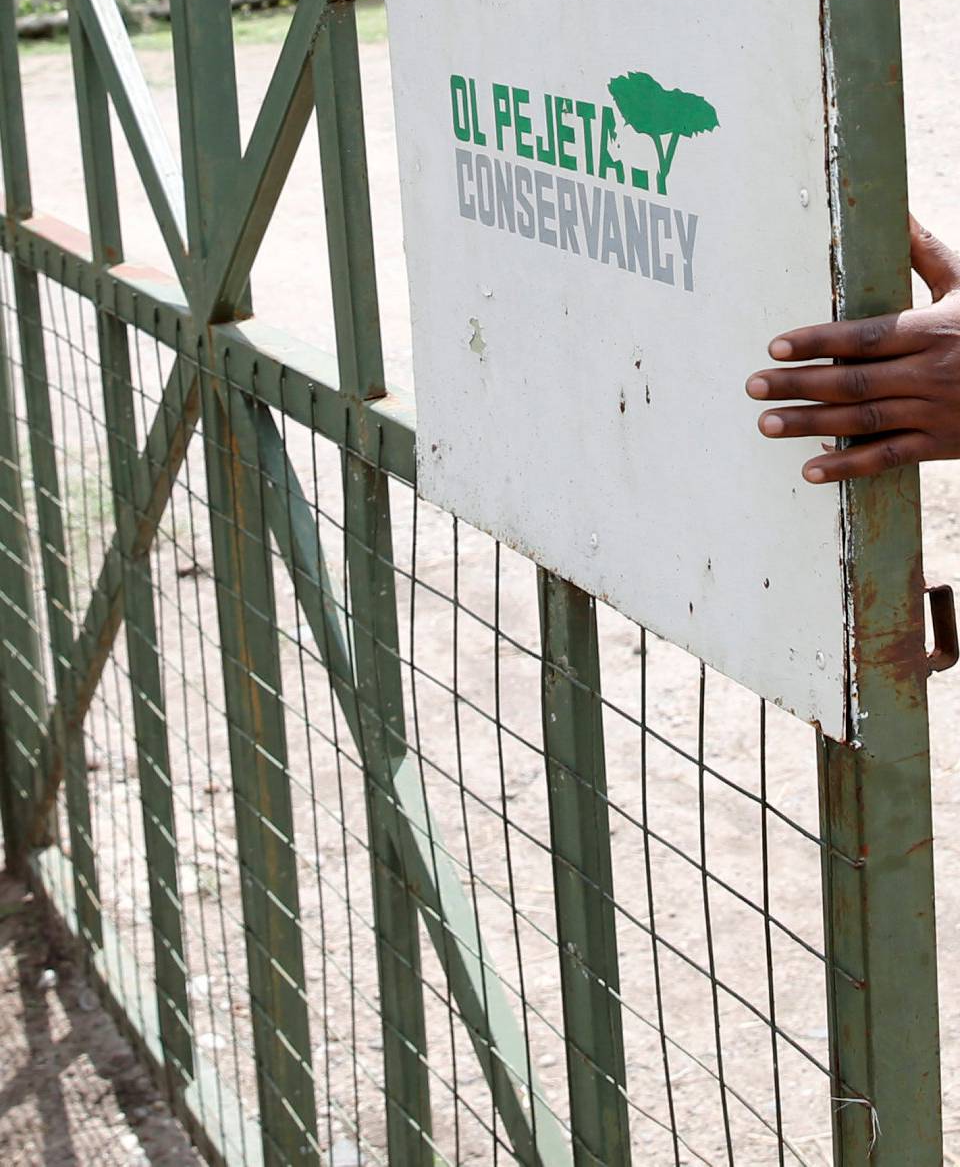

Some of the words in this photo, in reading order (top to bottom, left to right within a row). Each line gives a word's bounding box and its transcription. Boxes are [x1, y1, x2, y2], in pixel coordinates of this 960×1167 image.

[449, 74, 487, 147] OL
[492, 82, 625, 185] PEJETA
[455, 147, 699, 292] CONSERVANCY
